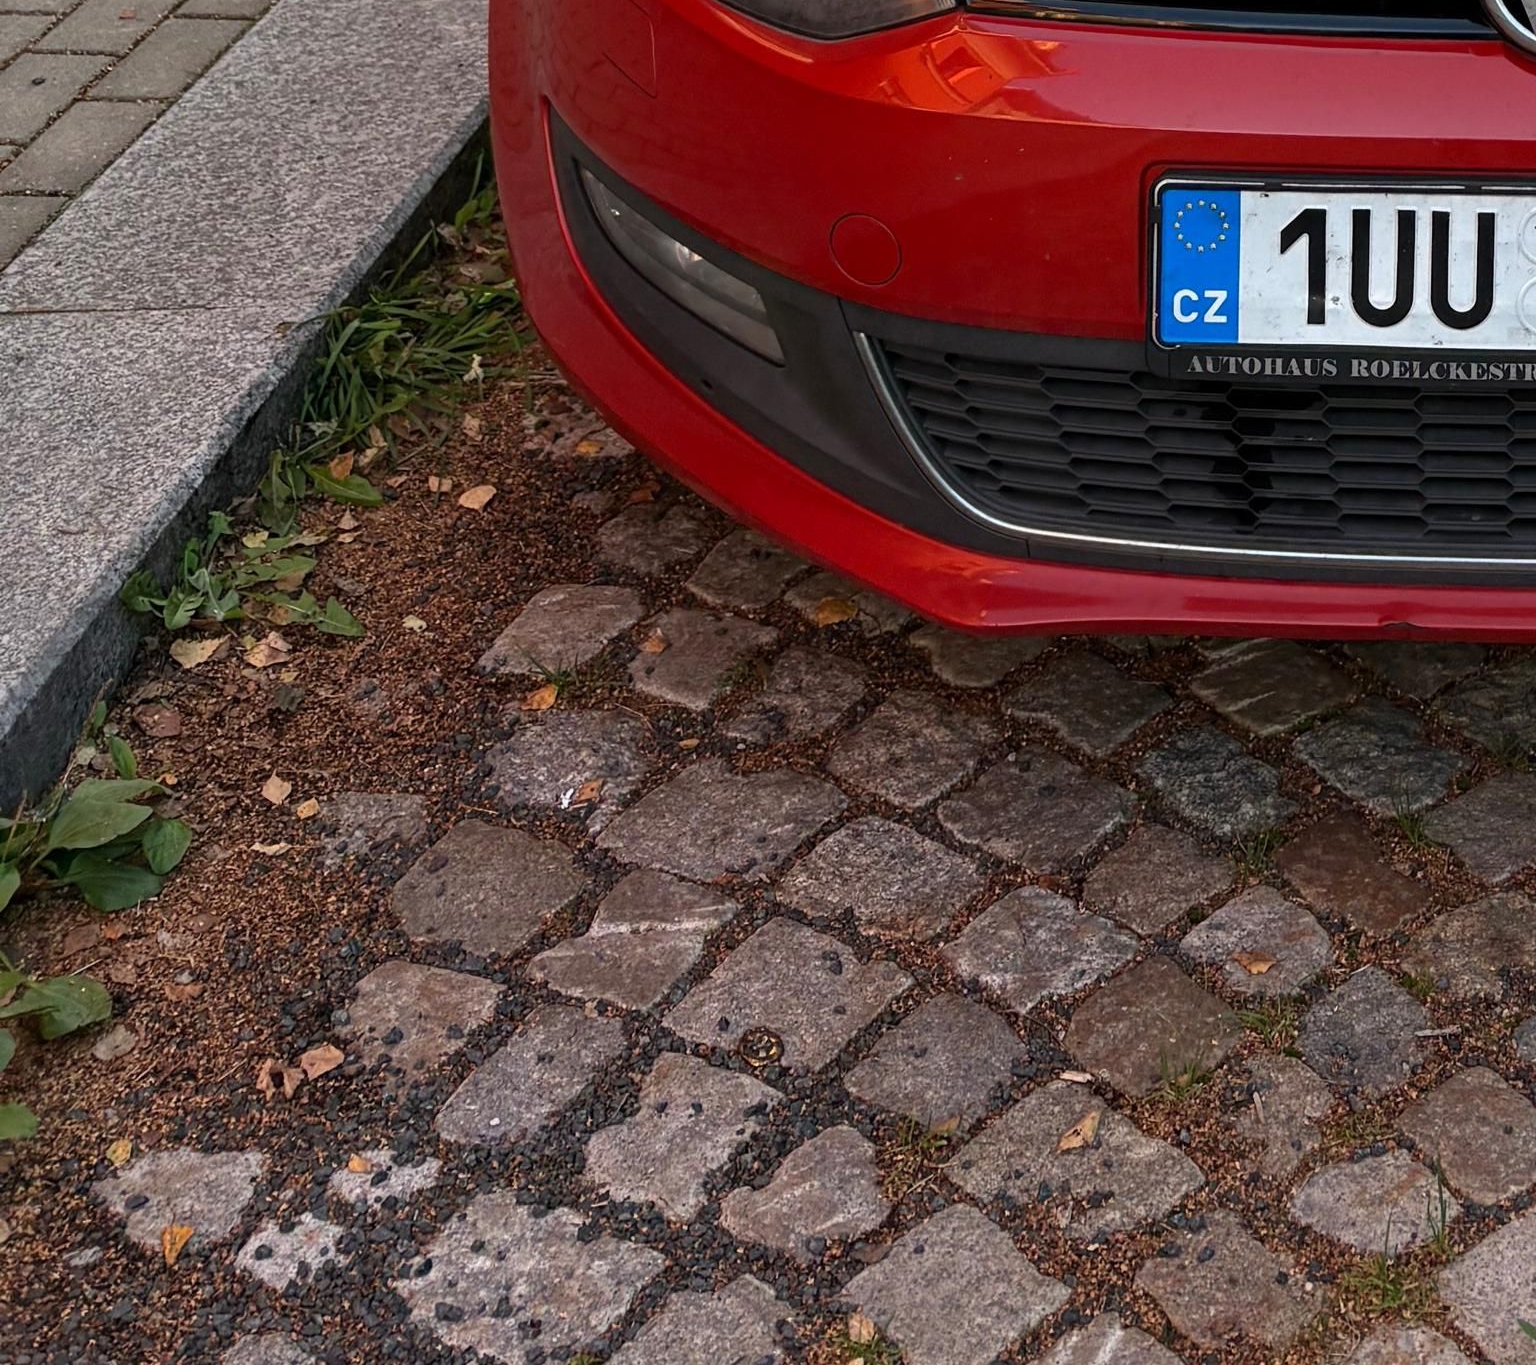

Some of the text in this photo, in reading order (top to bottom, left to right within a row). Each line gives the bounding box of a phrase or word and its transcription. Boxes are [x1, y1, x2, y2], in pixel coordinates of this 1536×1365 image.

[1279, 207, 1495, 330] 1UU
[1172, 289, 1229, 325] CZ
[1188, 355, 1338, 378] AUTOHAUS
